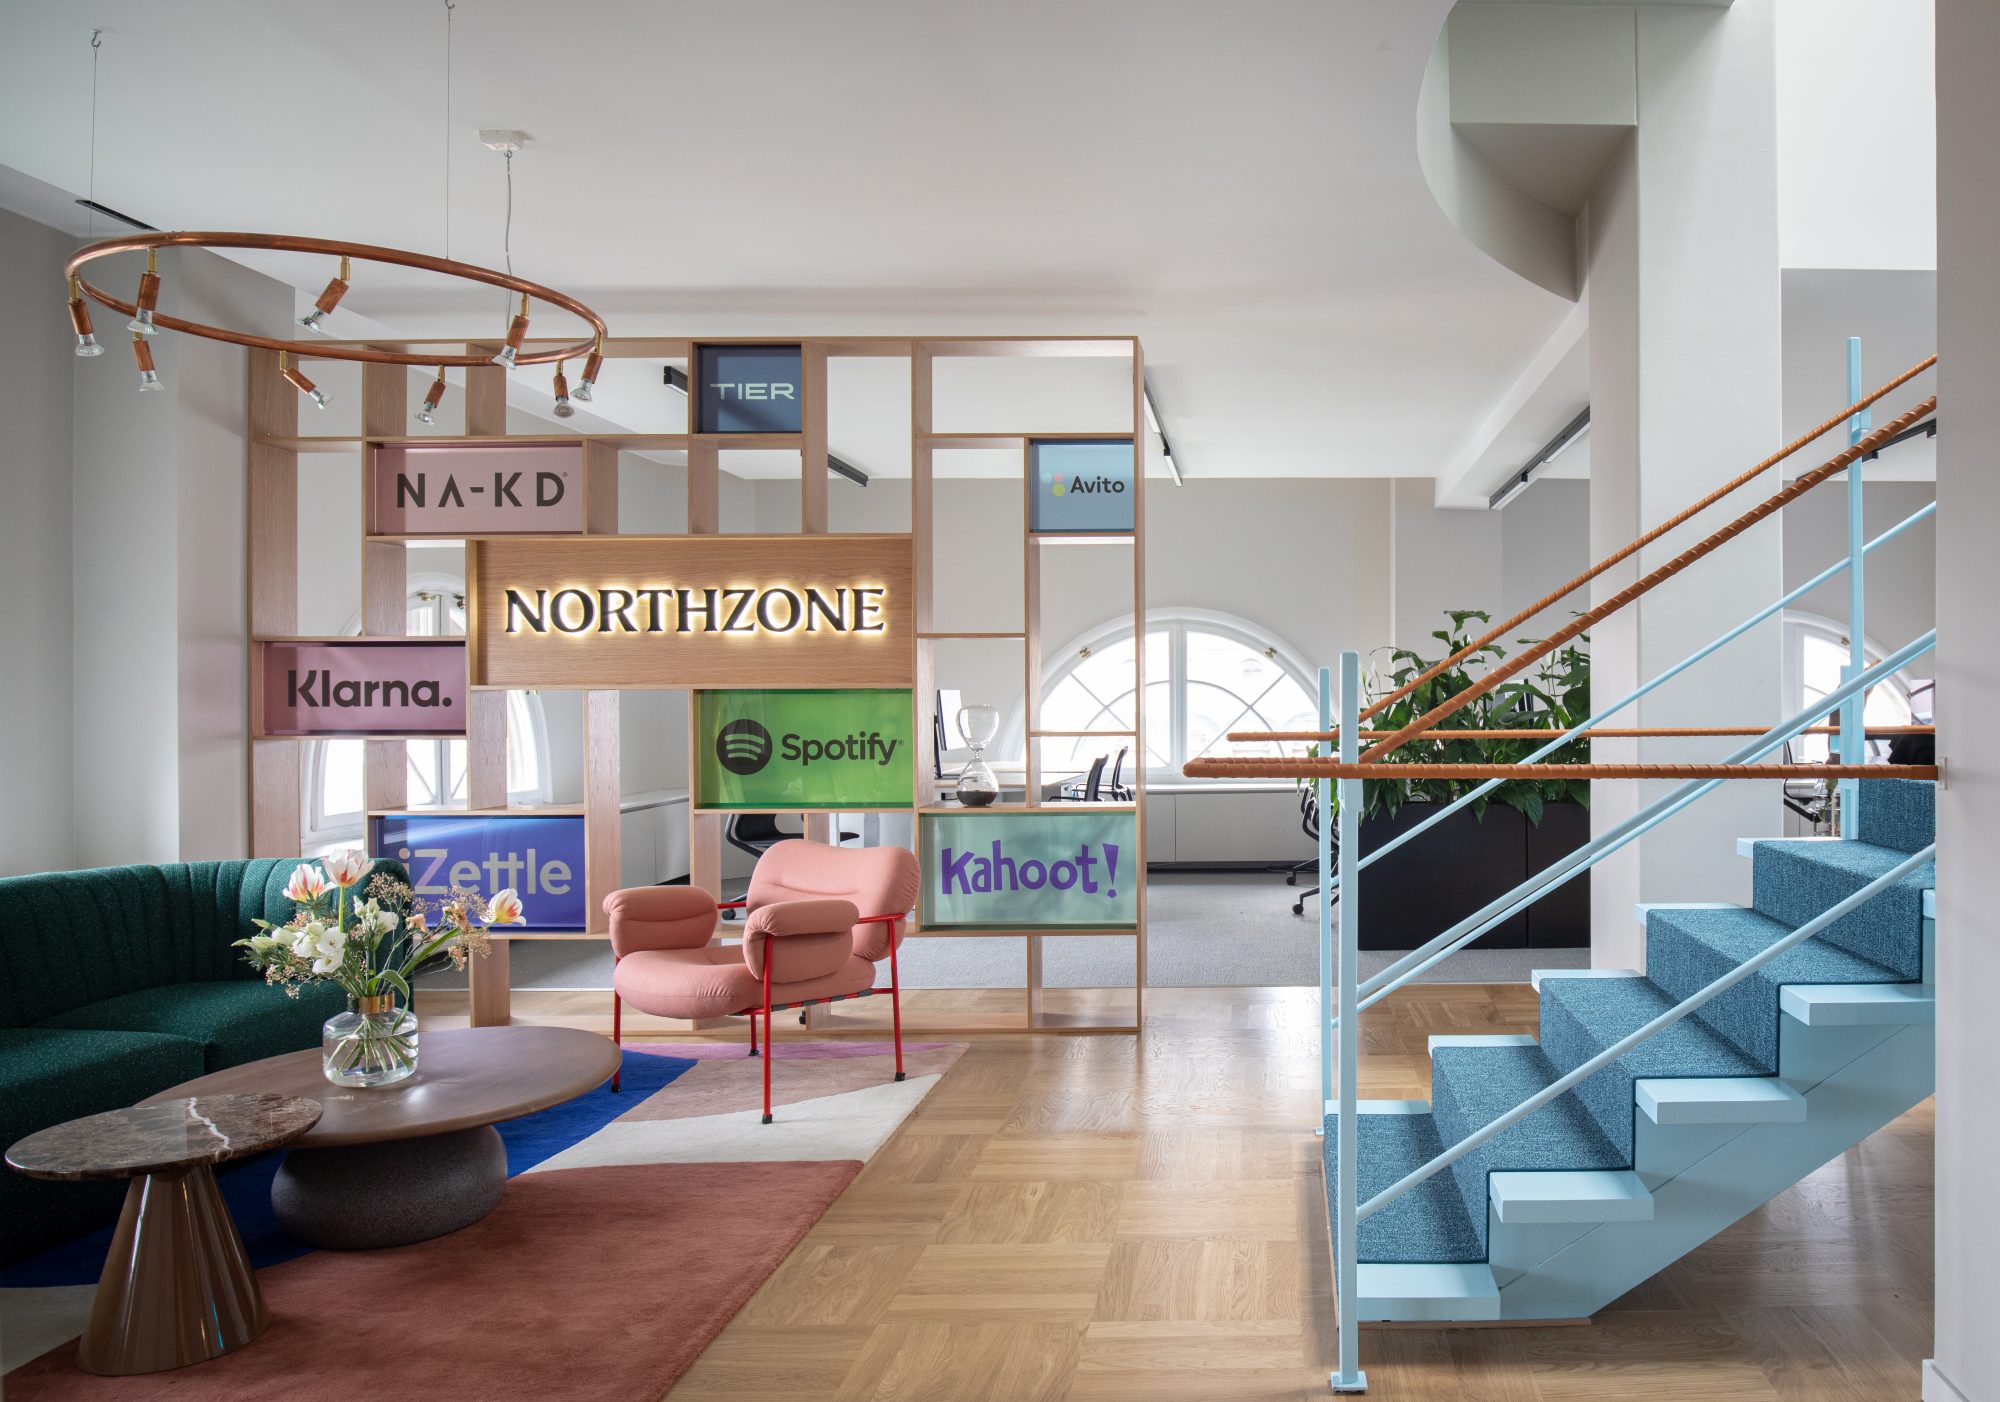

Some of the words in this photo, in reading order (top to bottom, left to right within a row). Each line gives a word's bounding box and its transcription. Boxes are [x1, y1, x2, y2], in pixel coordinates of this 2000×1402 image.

[710, 382, 796, 401] TIER
[1069, 475, 1126, 494] Avito
[505, 588, 885, 634] NORTHZONE
[287, 669, 453, 708] Klarna.
[781, 731, 898, 765] Spotify
[940, 839, 1120, 898] Kahoot!
